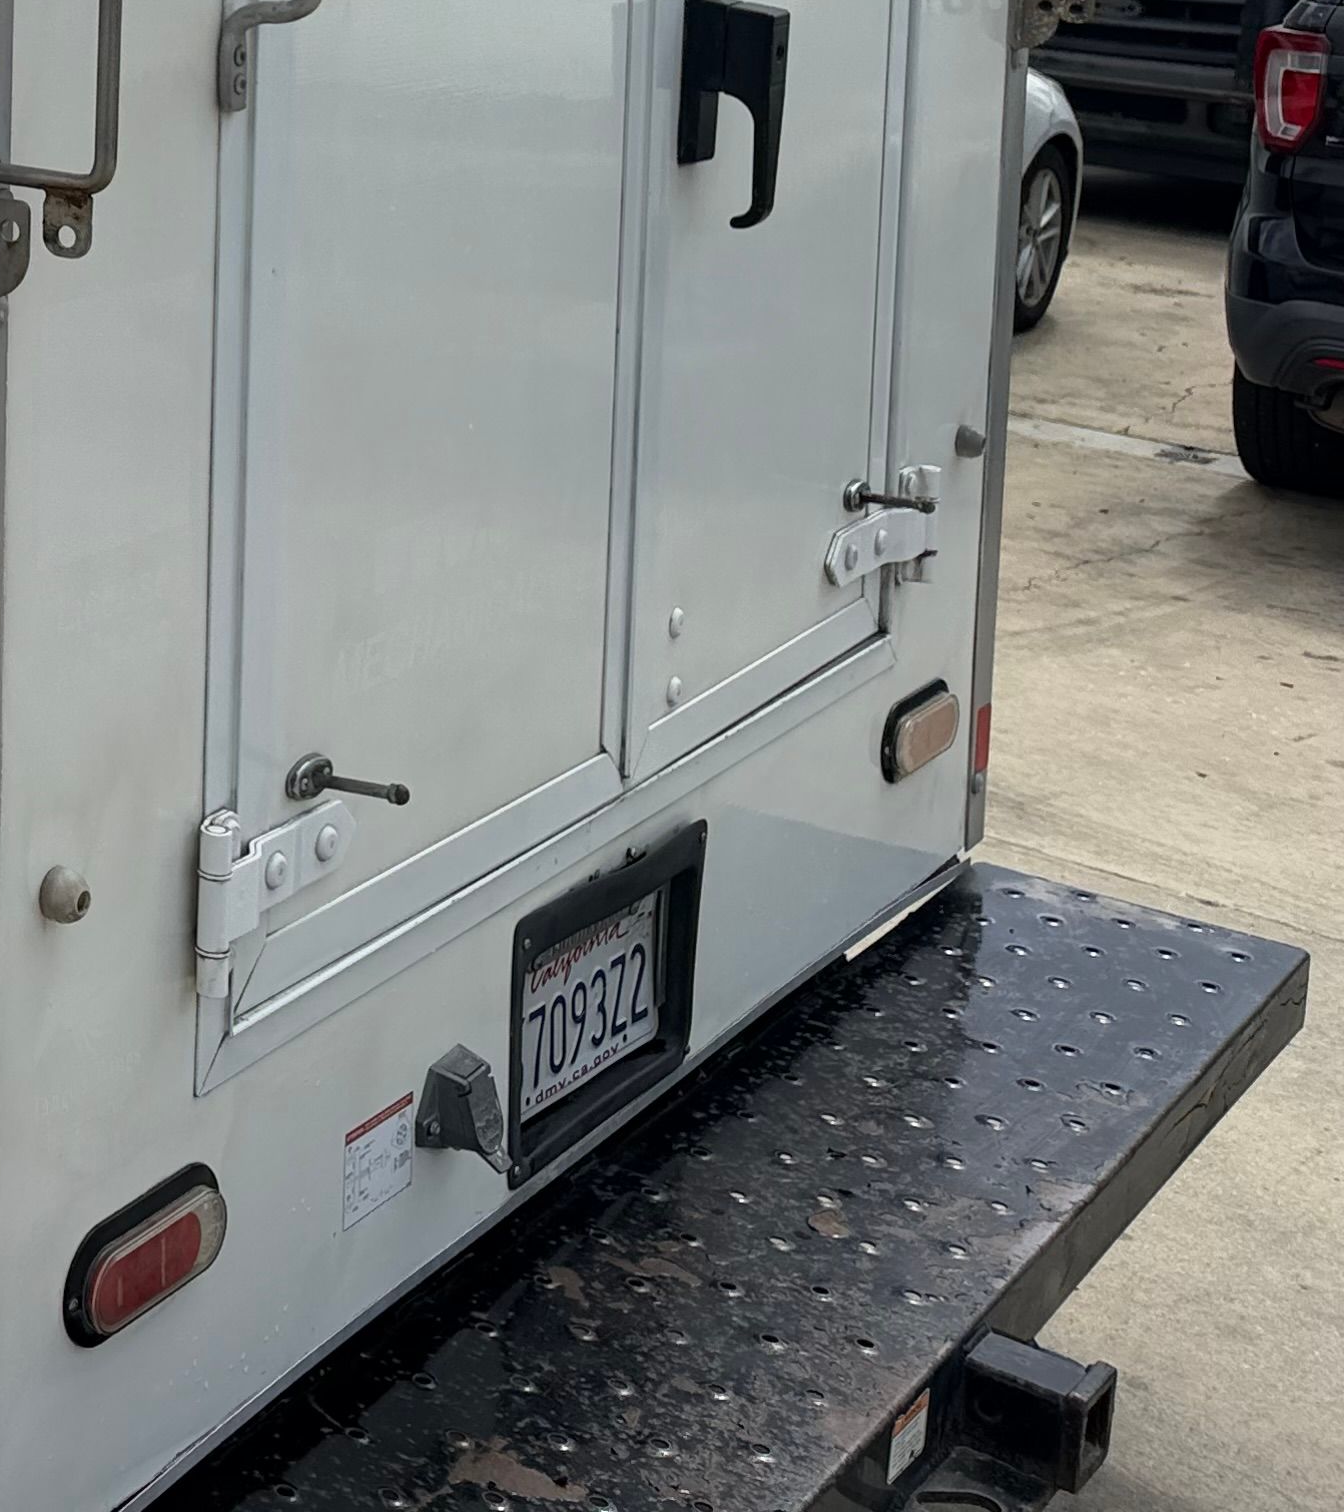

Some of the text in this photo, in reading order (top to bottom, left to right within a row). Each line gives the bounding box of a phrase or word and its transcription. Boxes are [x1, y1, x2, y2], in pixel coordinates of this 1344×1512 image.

[530, 921, 629, 994] California
[521, 942, 649, 1089] 7093Z2
[535, 1043, 620, 1105] dmv.ca.gov
